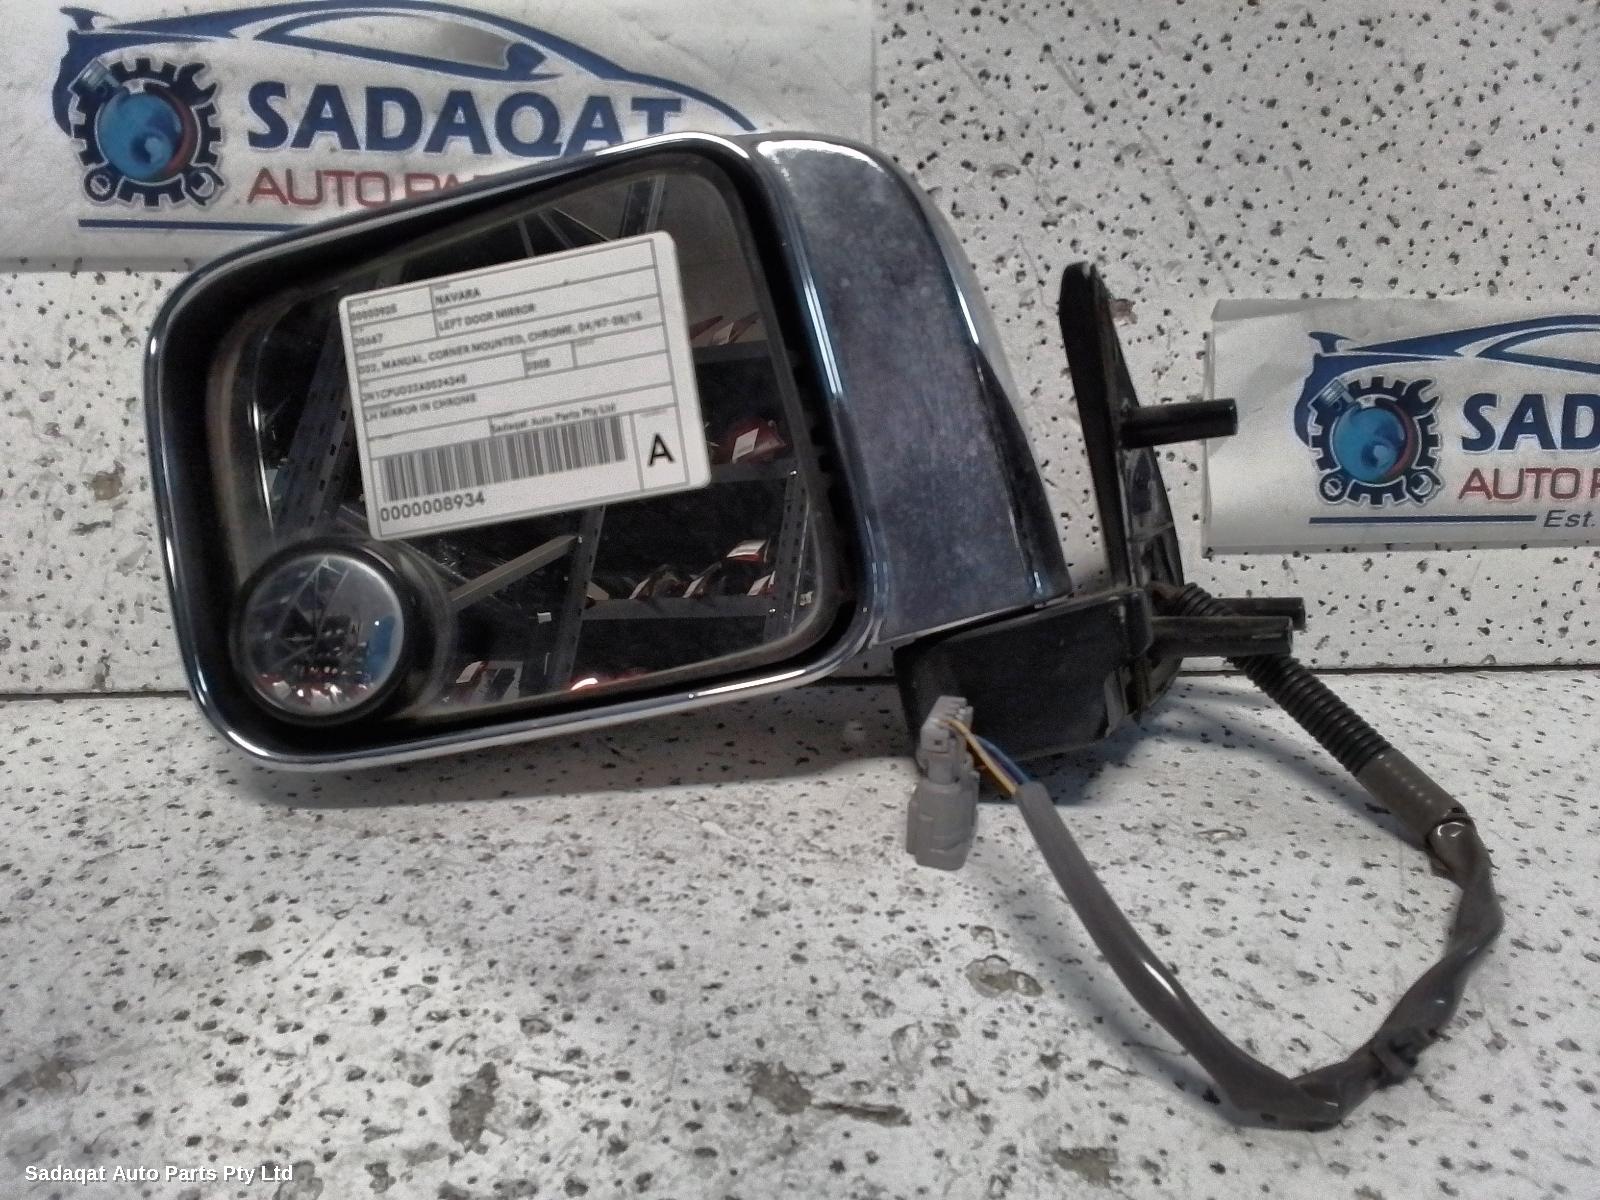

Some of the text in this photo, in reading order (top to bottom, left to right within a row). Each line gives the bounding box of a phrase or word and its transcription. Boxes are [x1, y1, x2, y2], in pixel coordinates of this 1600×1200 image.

[248, 82, 683, 157] SADAQAT
[248, 168, 391, 208] AUTO
[434, 287, 480, 304] NAVARA
[438, 317, 462, 331] LEFT
[464, 311, 493, 325] DOOR
[495, 303, 535, 319] MIRROR
[427, 345, 469, 360] CORNER
[379, 404, 417, 419] MIRROR
[419, 401, 430, 411] IN
[432, 393, 475, 409] CHROME
[1461, 392, 1600, 452] SAD
[647, 433, 675, 467] A
[1458, 467, 1581, 500] AUTO
[380, 493, 486, 522] 0000008934
[1543, 509, 1596, 528] Est.
